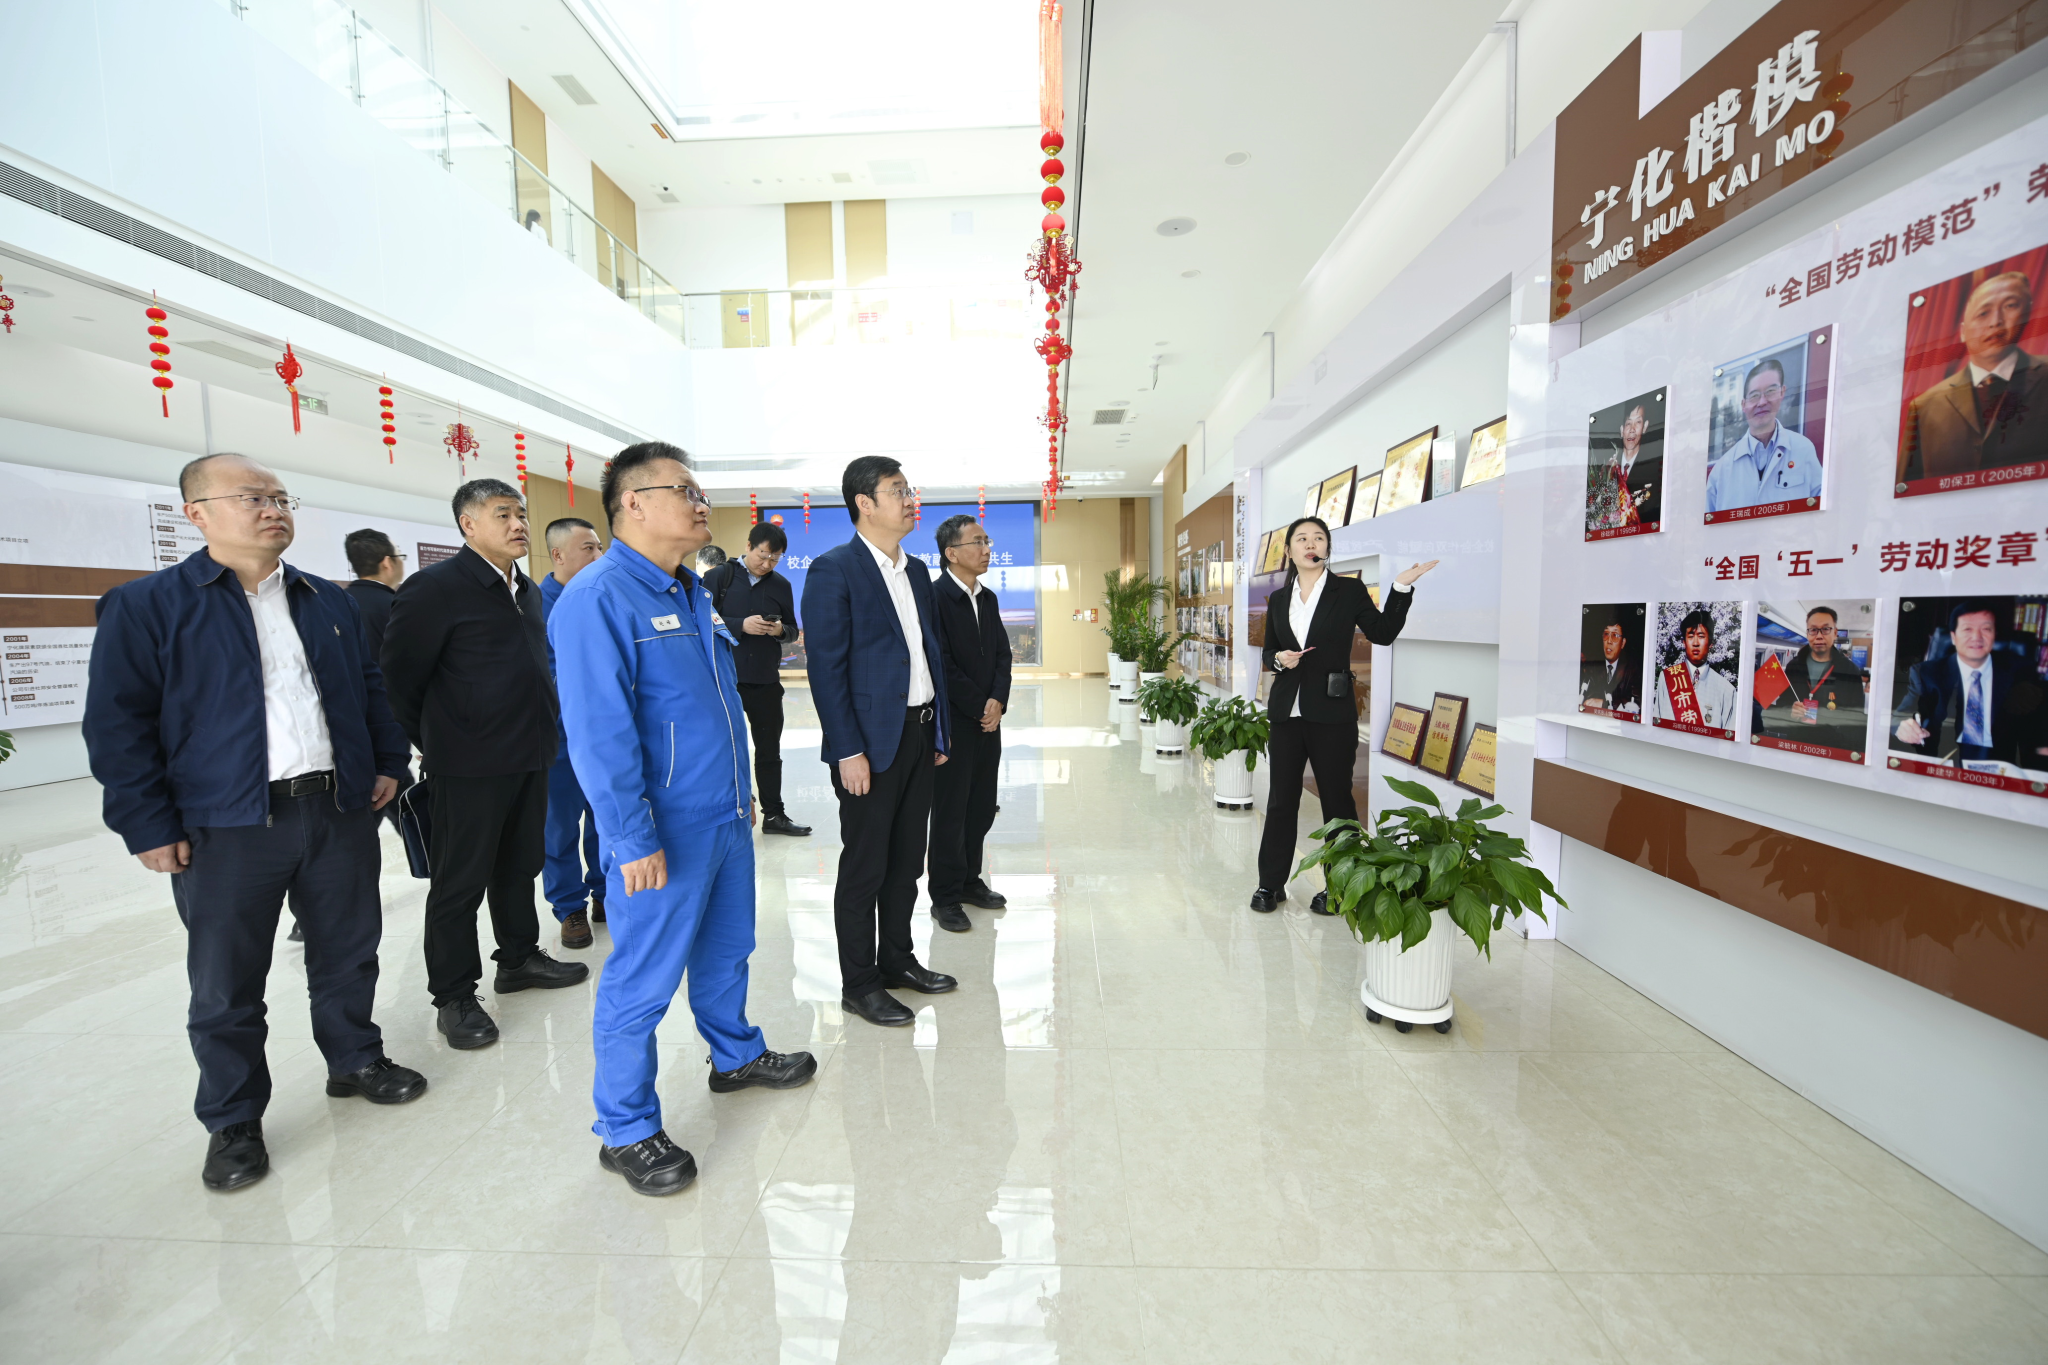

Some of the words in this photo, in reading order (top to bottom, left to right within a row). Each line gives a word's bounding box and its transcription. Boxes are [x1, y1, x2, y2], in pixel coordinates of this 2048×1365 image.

[1580, 29, 1820, 249] 宁化楷模
[1584, 237, 1634, 284] NING
[1643, 198, 1694, 247] HUA
[1707, 153, 1760, 207] KAI
[1775, 110, 1835, 167] MO
[307, 397, 318, 410] 1F
[1704, 528, 2048, 580] “全国‘五一’劳动奖章
